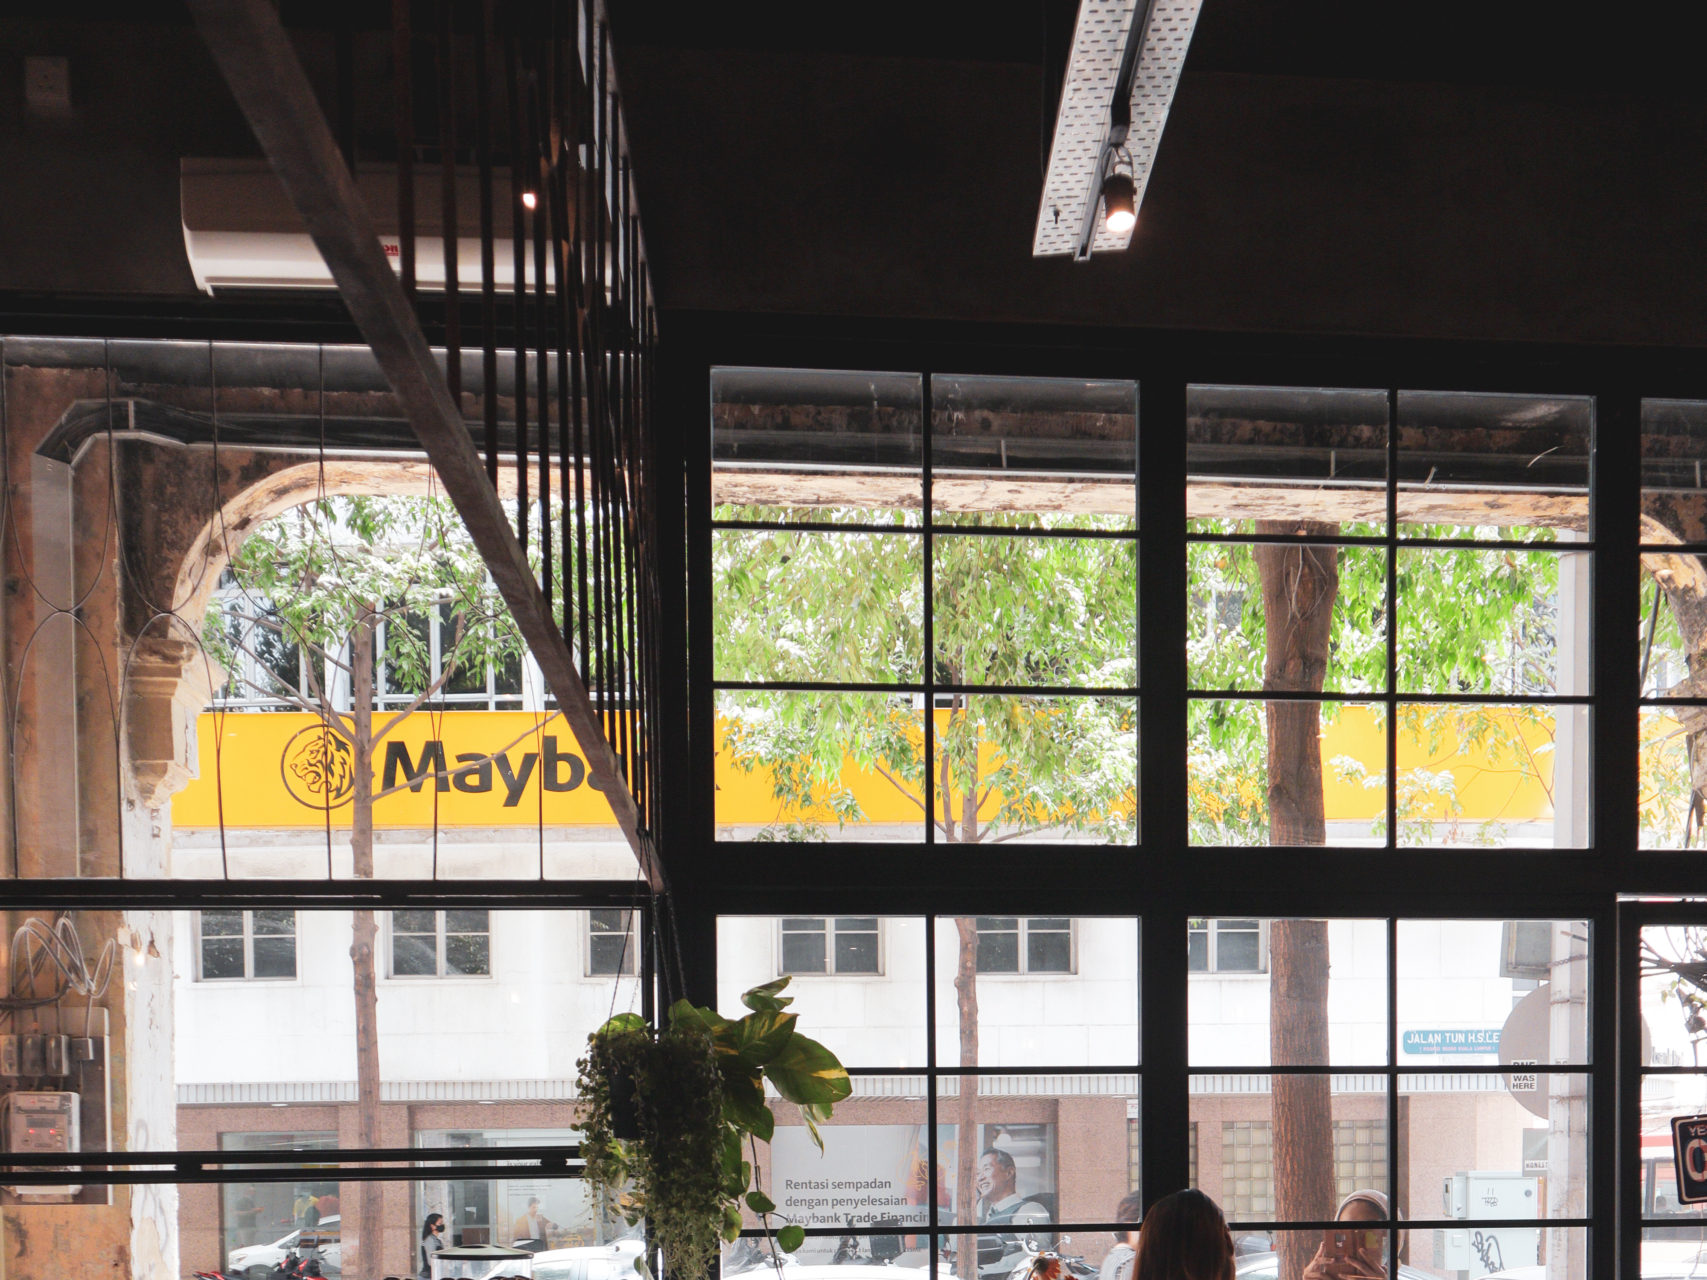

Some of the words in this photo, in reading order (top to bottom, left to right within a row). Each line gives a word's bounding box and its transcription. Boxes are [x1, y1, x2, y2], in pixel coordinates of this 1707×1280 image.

[1407, 1032, 1442, 1044] JALAN
[1444, 1032, 1465, 1043] TUN
[1688, 1125, 1707, 1136] YE
[785, 1179, 829, 1190] Rentasi
[831, 1178, 891, 1192] sempadan
[785, 1196, 828, 1209] dengan
[831, 1195, 908, 1209] penyelesaian
[785, 1212, 841, 1226] Maybank
[843, 1212, 878, 1223] Trade
